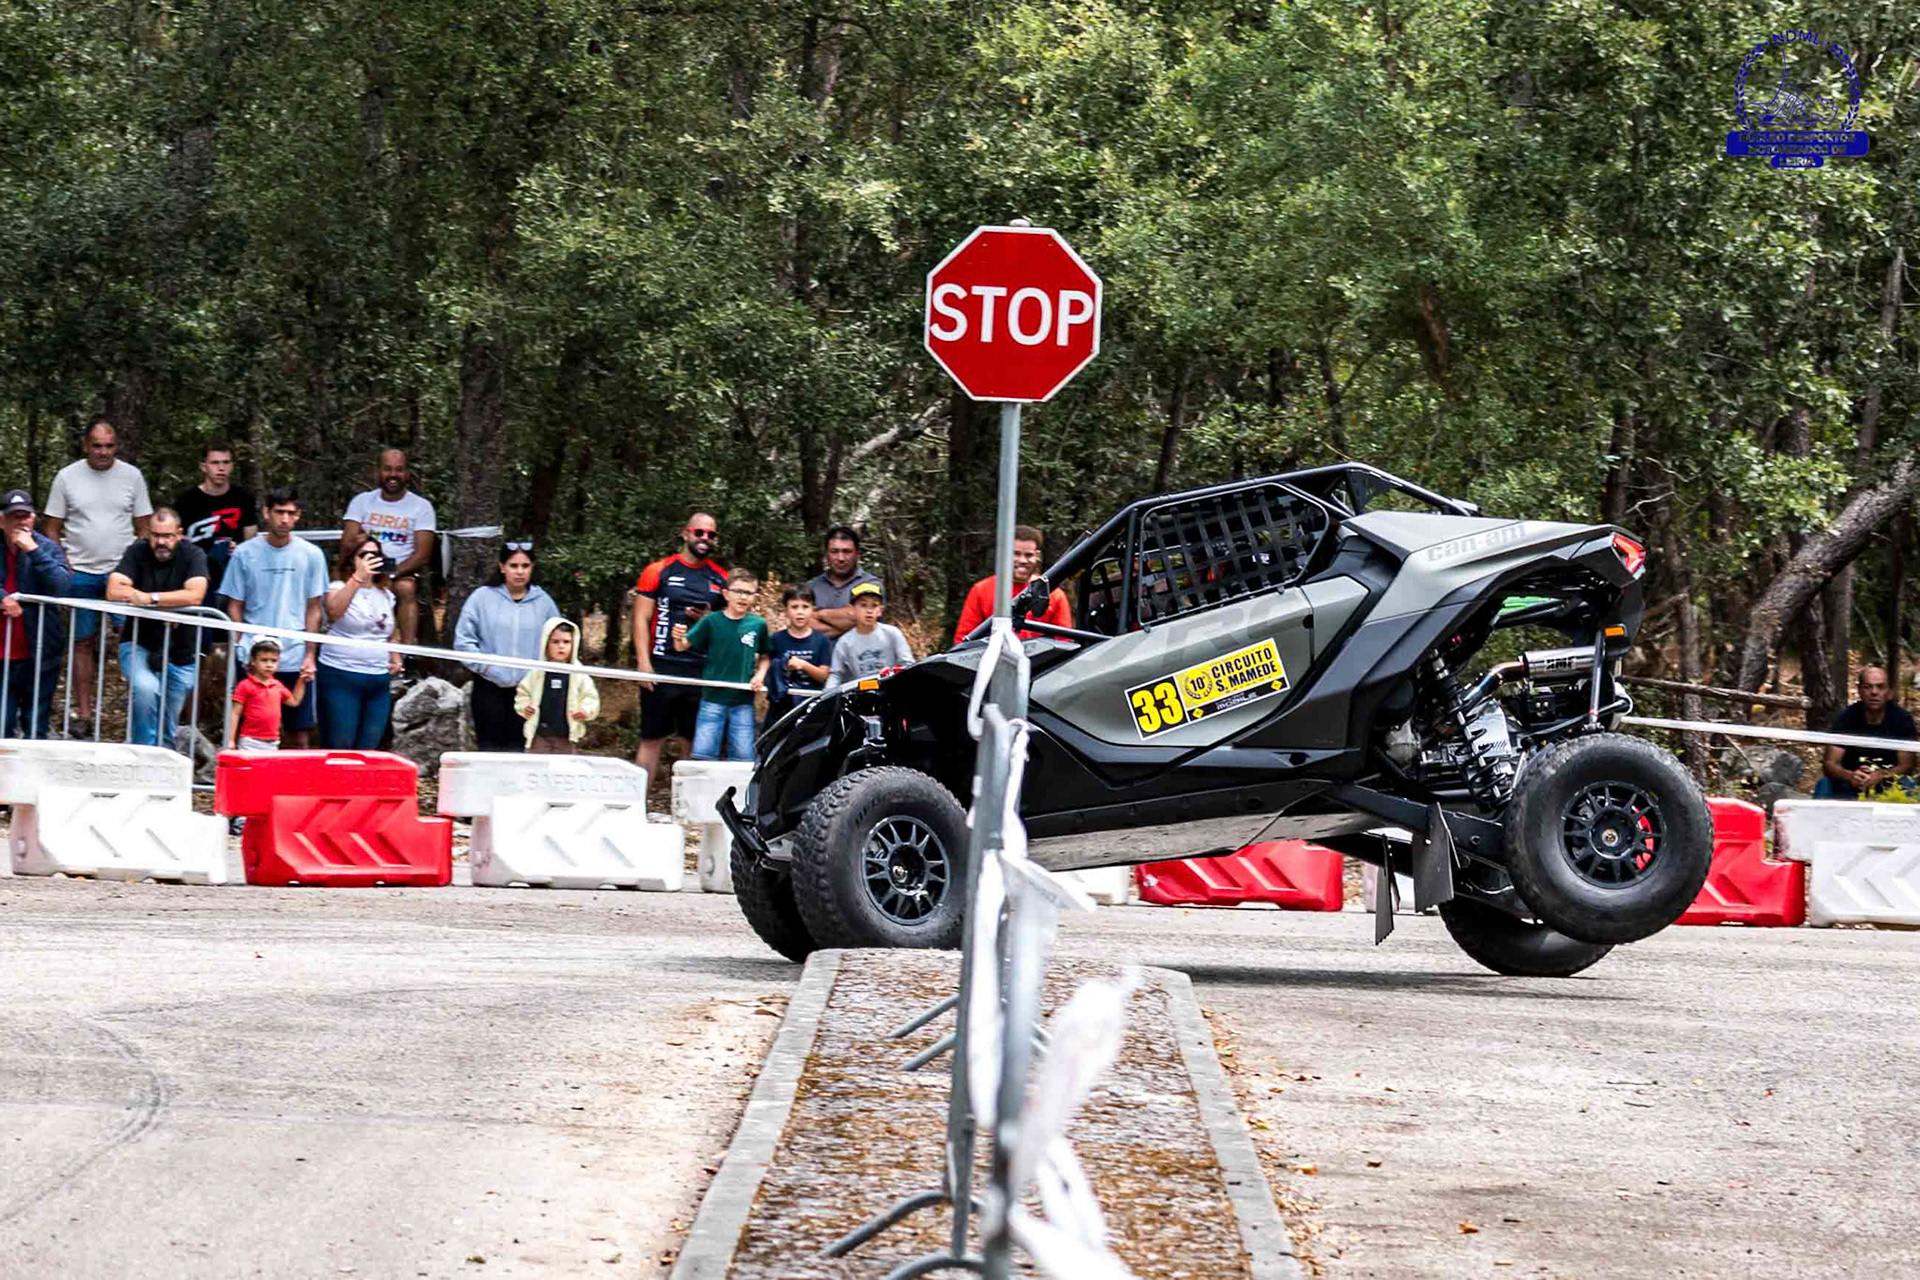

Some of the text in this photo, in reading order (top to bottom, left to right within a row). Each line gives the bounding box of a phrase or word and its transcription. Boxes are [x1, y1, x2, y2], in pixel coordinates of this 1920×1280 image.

[930, 283, 1094, 347] STOP
[187, 508, 242, 543] GR
[652, 596, 669, 656] RACING
[1211, 647, 1273, 679] CIRCUITO
[1216, 679, 1229, 692] S.
[1228, 660, 1278, 688] MAMEDE
[1131, 682, 1184, 733] 33
